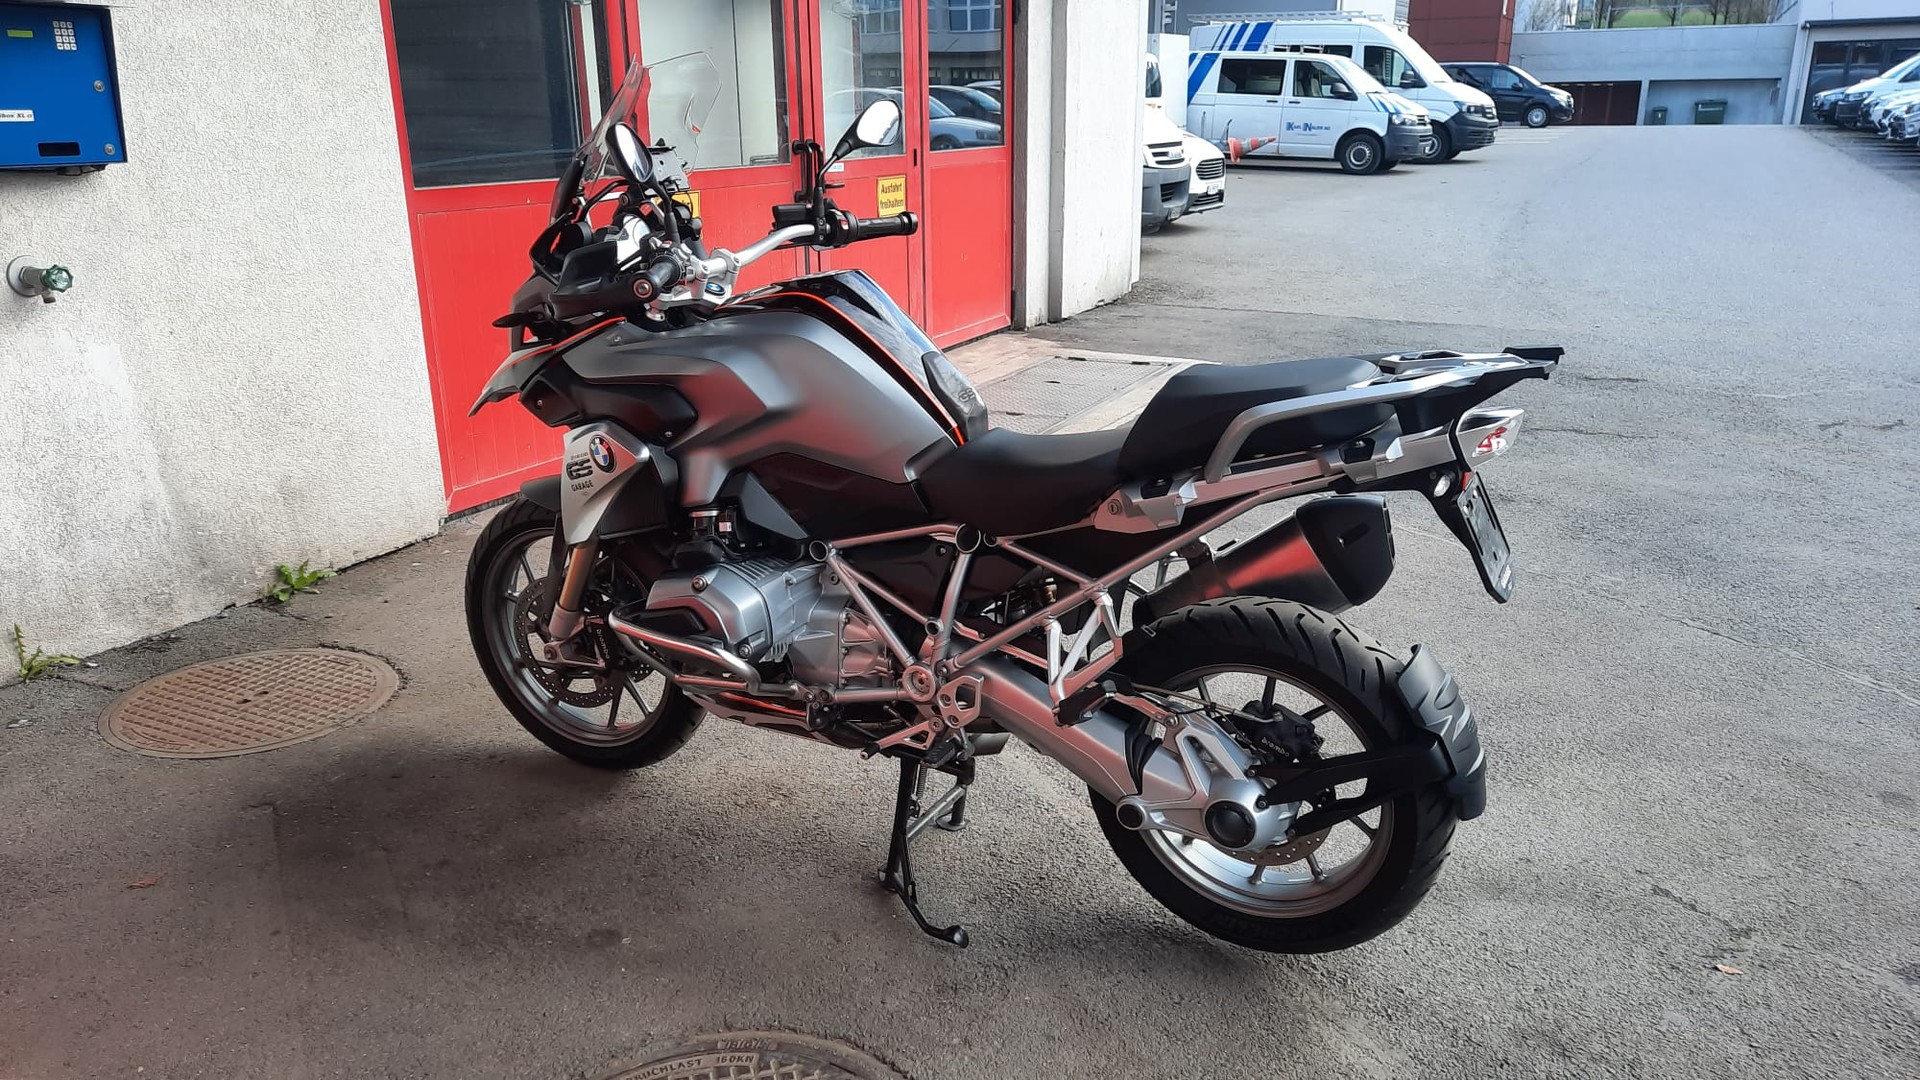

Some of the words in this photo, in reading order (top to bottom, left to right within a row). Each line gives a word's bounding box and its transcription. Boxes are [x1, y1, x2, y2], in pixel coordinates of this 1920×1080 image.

[881, 183, 902, 194] Ausfahrt
[880, 198, 904, 209] freihalten
[571, 480, 594, 491] GARAGE
[597, 629, 611, 659] brembo
[1261, 737, 1290, 757] brembo
